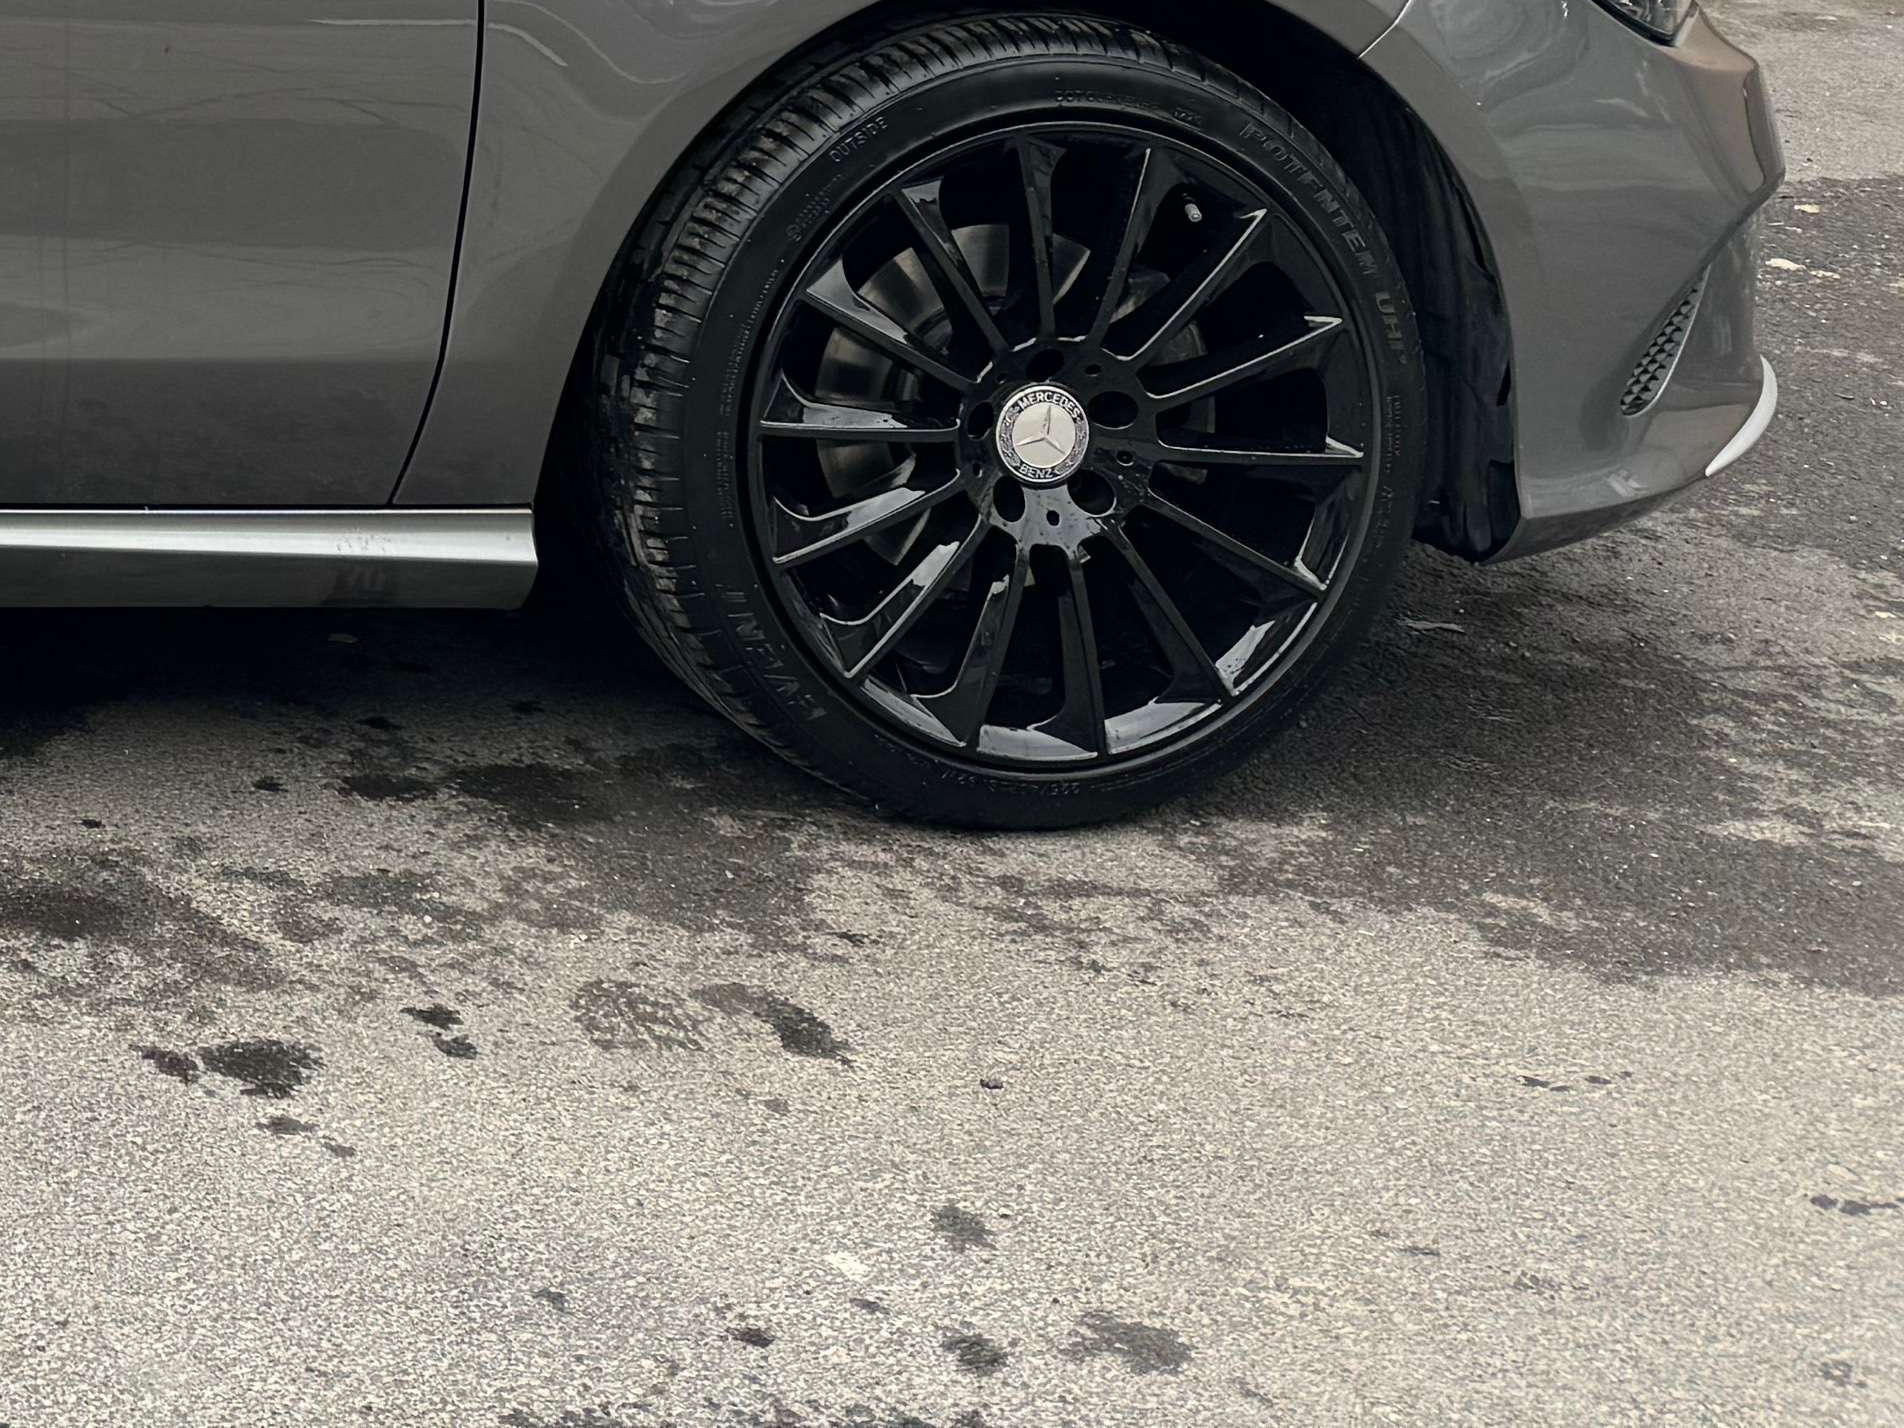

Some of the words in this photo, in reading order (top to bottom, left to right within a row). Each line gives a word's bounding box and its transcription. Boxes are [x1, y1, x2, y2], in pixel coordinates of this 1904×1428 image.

[827, 114, 891, 164] OUTSIDE
[1017, 391, 1081, 422] MERCEDES
[1019, 464, 1055, 479] BENZ
